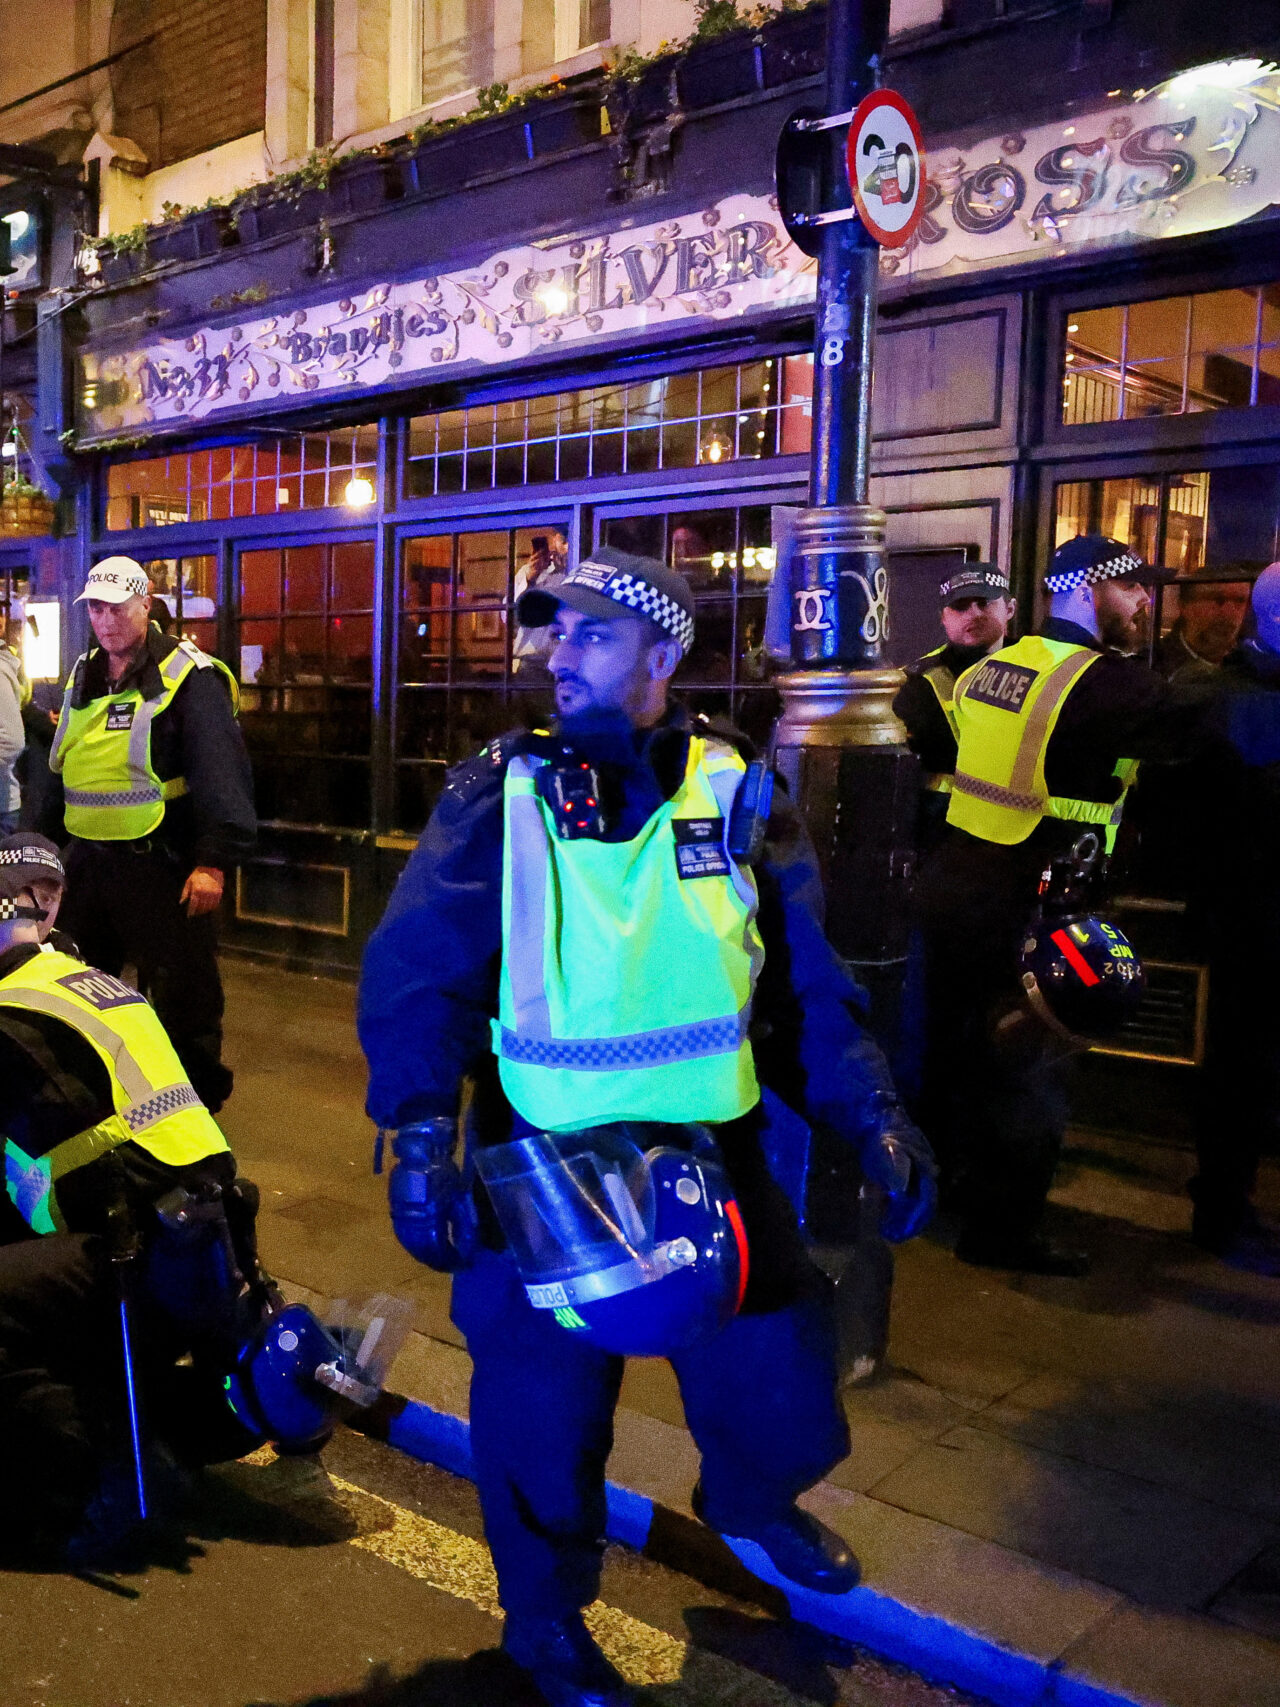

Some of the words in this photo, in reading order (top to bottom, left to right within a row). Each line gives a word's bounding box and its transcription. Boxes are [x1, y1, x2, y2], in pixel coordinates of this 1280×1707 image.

[513, 220, 780, 328] SILVER
[821, 336, 844, 366] 8
[89, 573, 120, 584] POLICE
[970, 665, 1030, 704] POLICE
